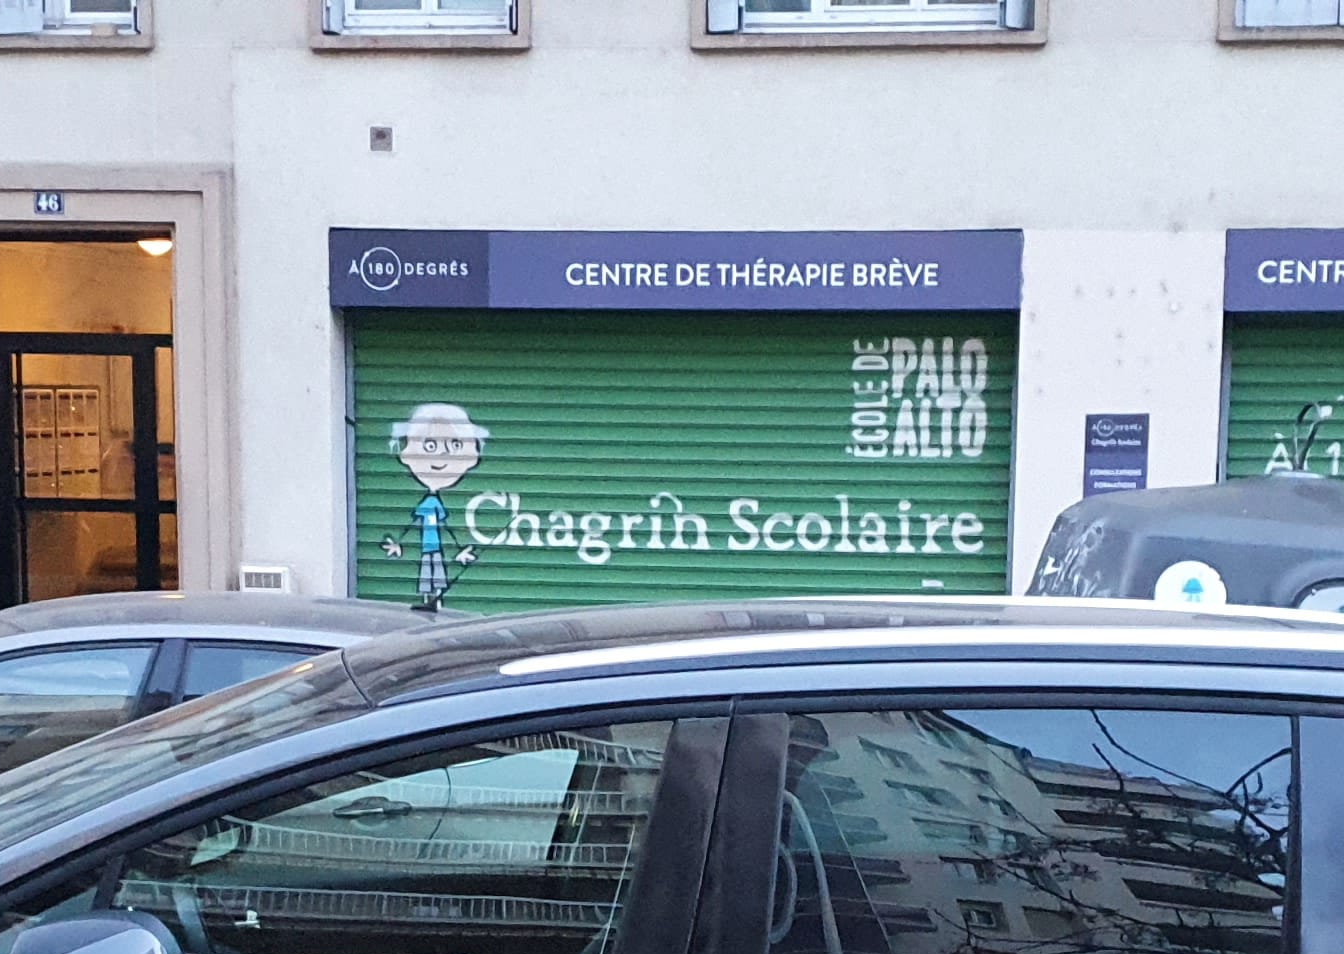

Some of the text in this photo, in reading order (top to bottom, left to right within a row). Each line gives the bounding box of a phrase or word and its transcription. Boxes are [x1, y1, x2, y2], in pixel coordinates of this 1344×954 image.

[38, 194, 59, 211] 46
[367, 262, 395, 276] 180
[404, 260, 469, 276] DEGRÉS
[565, 257, 939, 287] CENTRE DE THÉRAPIE BRÈVE
[845, 337, 890, 458] ÉCOLE DE
[892, 336, 988, 398] PALO
[892, 395, 988, 458] ALTO
[465, 491, 984, 565] Chagrin Scolaire
